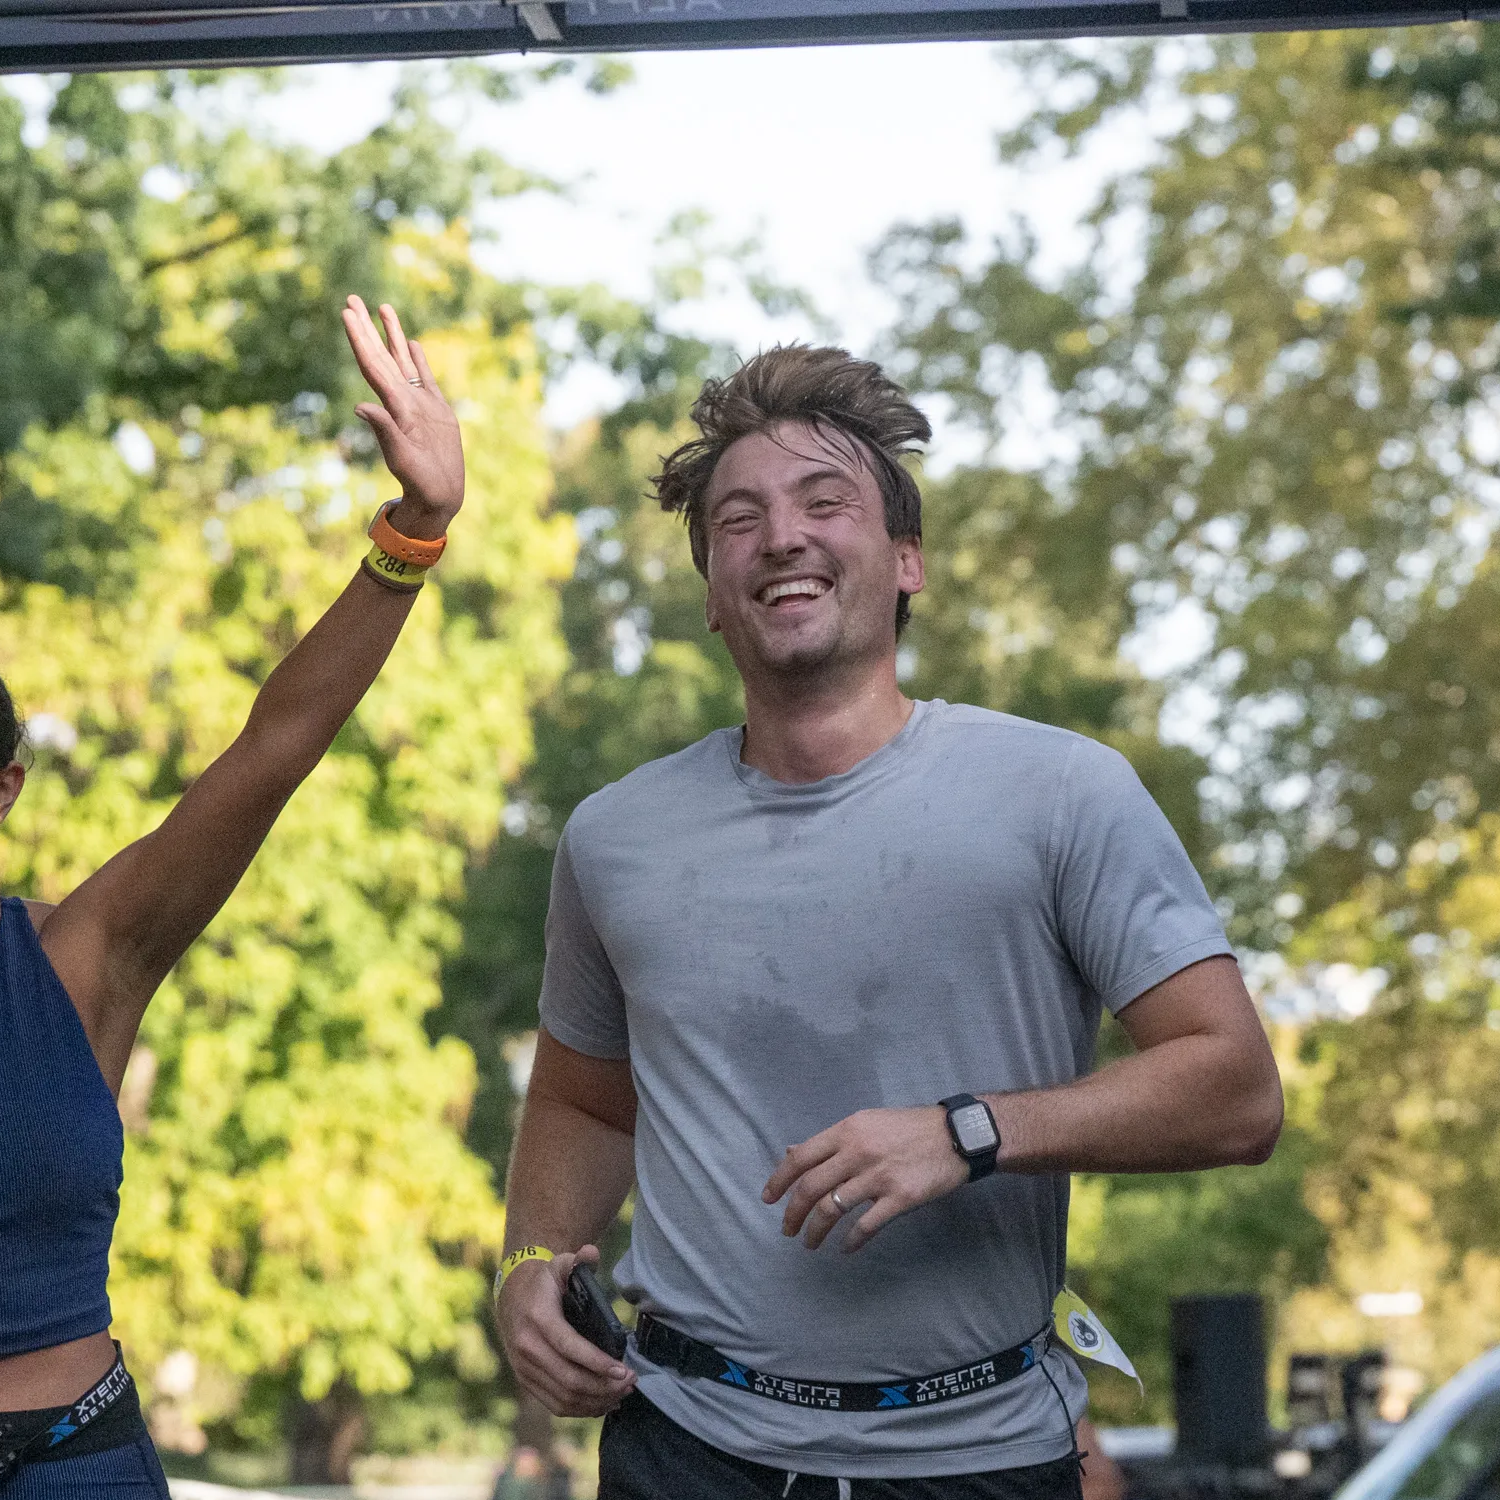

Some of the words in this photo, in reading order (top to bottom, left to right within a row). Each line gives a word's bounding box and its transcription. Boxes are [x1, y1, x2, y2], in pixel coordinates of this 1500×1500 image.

[375, 551, 408, 577] 284
[509, 1246, 537, 1266] 276
[75, 1361, 125, 1416] XTERRA
[755, 1372, 841, 1398] XTERRA
[917, 1361, 995, 1393] XTERRA
[917, 1374, 996, 1402] WETSUITS
[754, 1383, 840, 1408] WETSUITS
